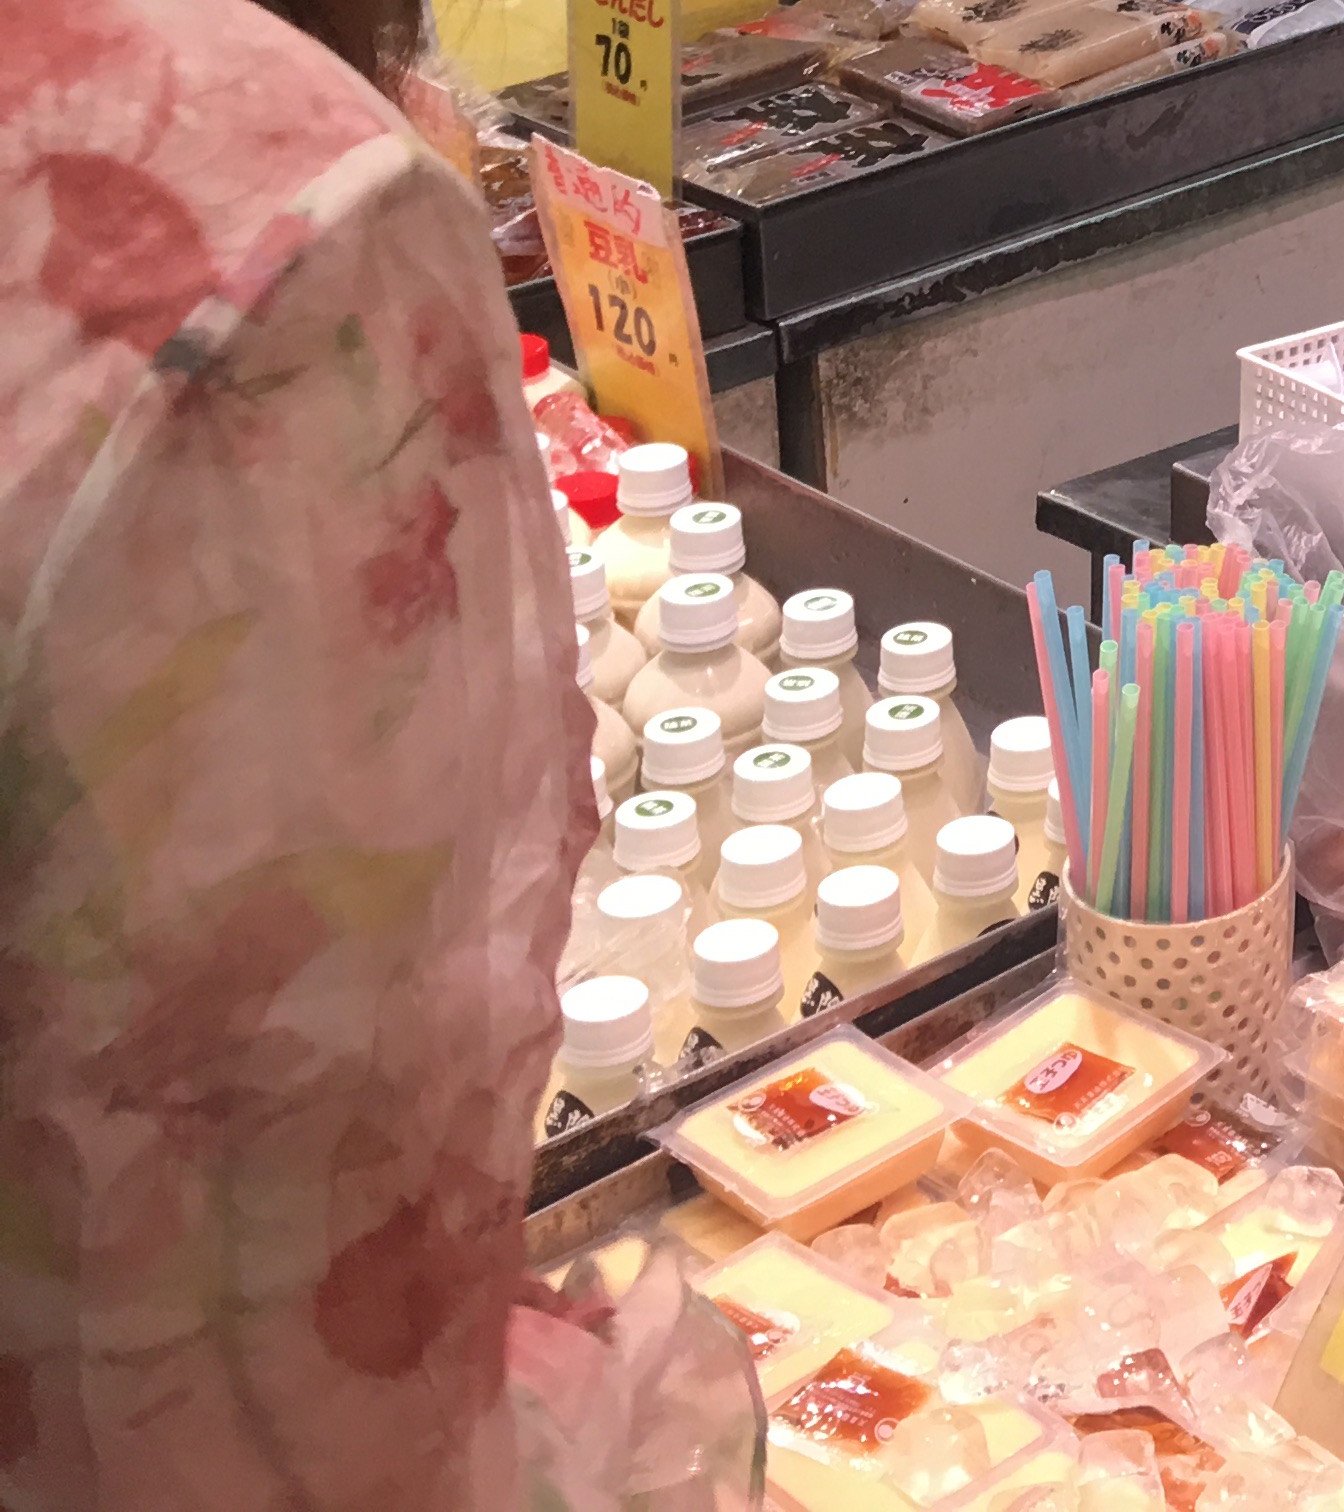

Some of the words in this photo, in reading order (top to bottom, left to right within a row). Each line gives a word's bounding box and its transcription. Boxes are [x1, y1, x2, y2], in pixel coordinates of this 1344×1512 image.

[594, 33, 632, 86] 70
[584, 219, 648, 284] 豆乳
[588, 283, 657, 357] 120
